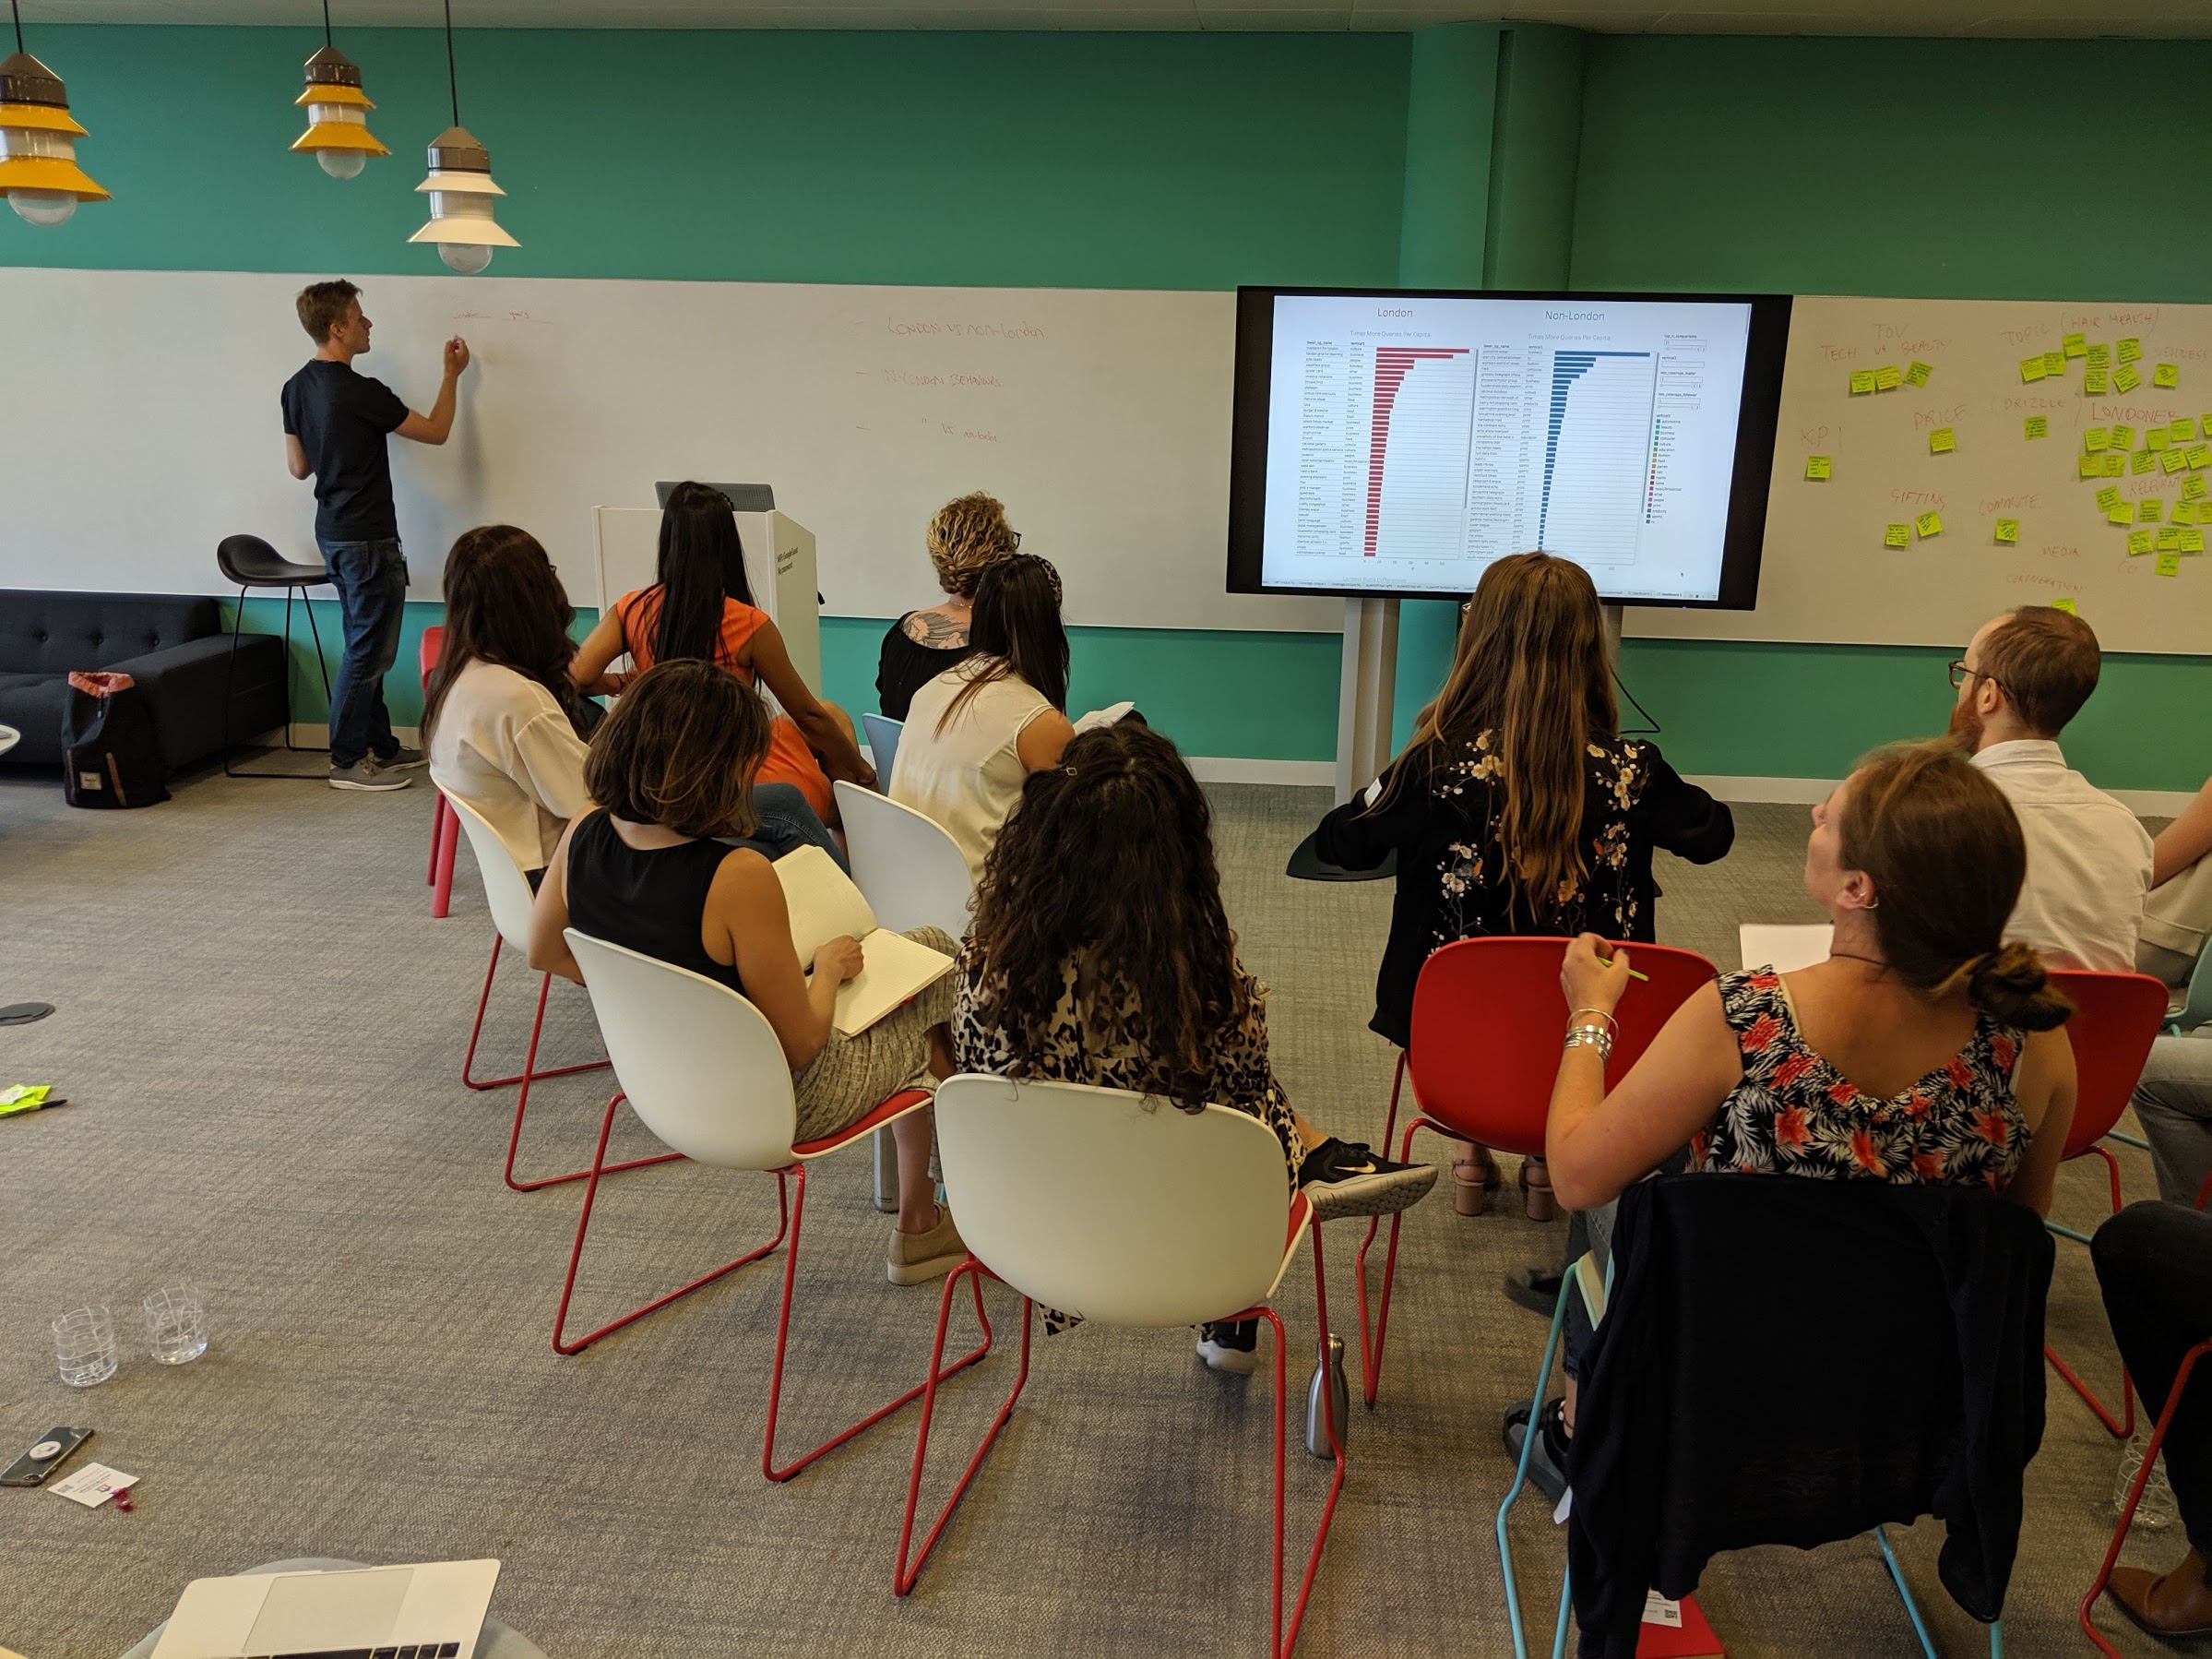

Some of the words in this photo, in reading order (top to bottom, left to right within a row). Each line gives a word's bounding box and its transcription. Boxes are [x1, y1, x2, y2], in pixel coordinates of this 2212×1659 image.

[1377, 308, 1413, 318] London
[1546, 310, 1605, 321] Non-London
[887, 316, 941, 336] LONDON
[1821, 344, 1856, 361] TECH
[1901, 339, 1952, 355] BEAUTY
[1914, 404, 1967, 431] PRICE
